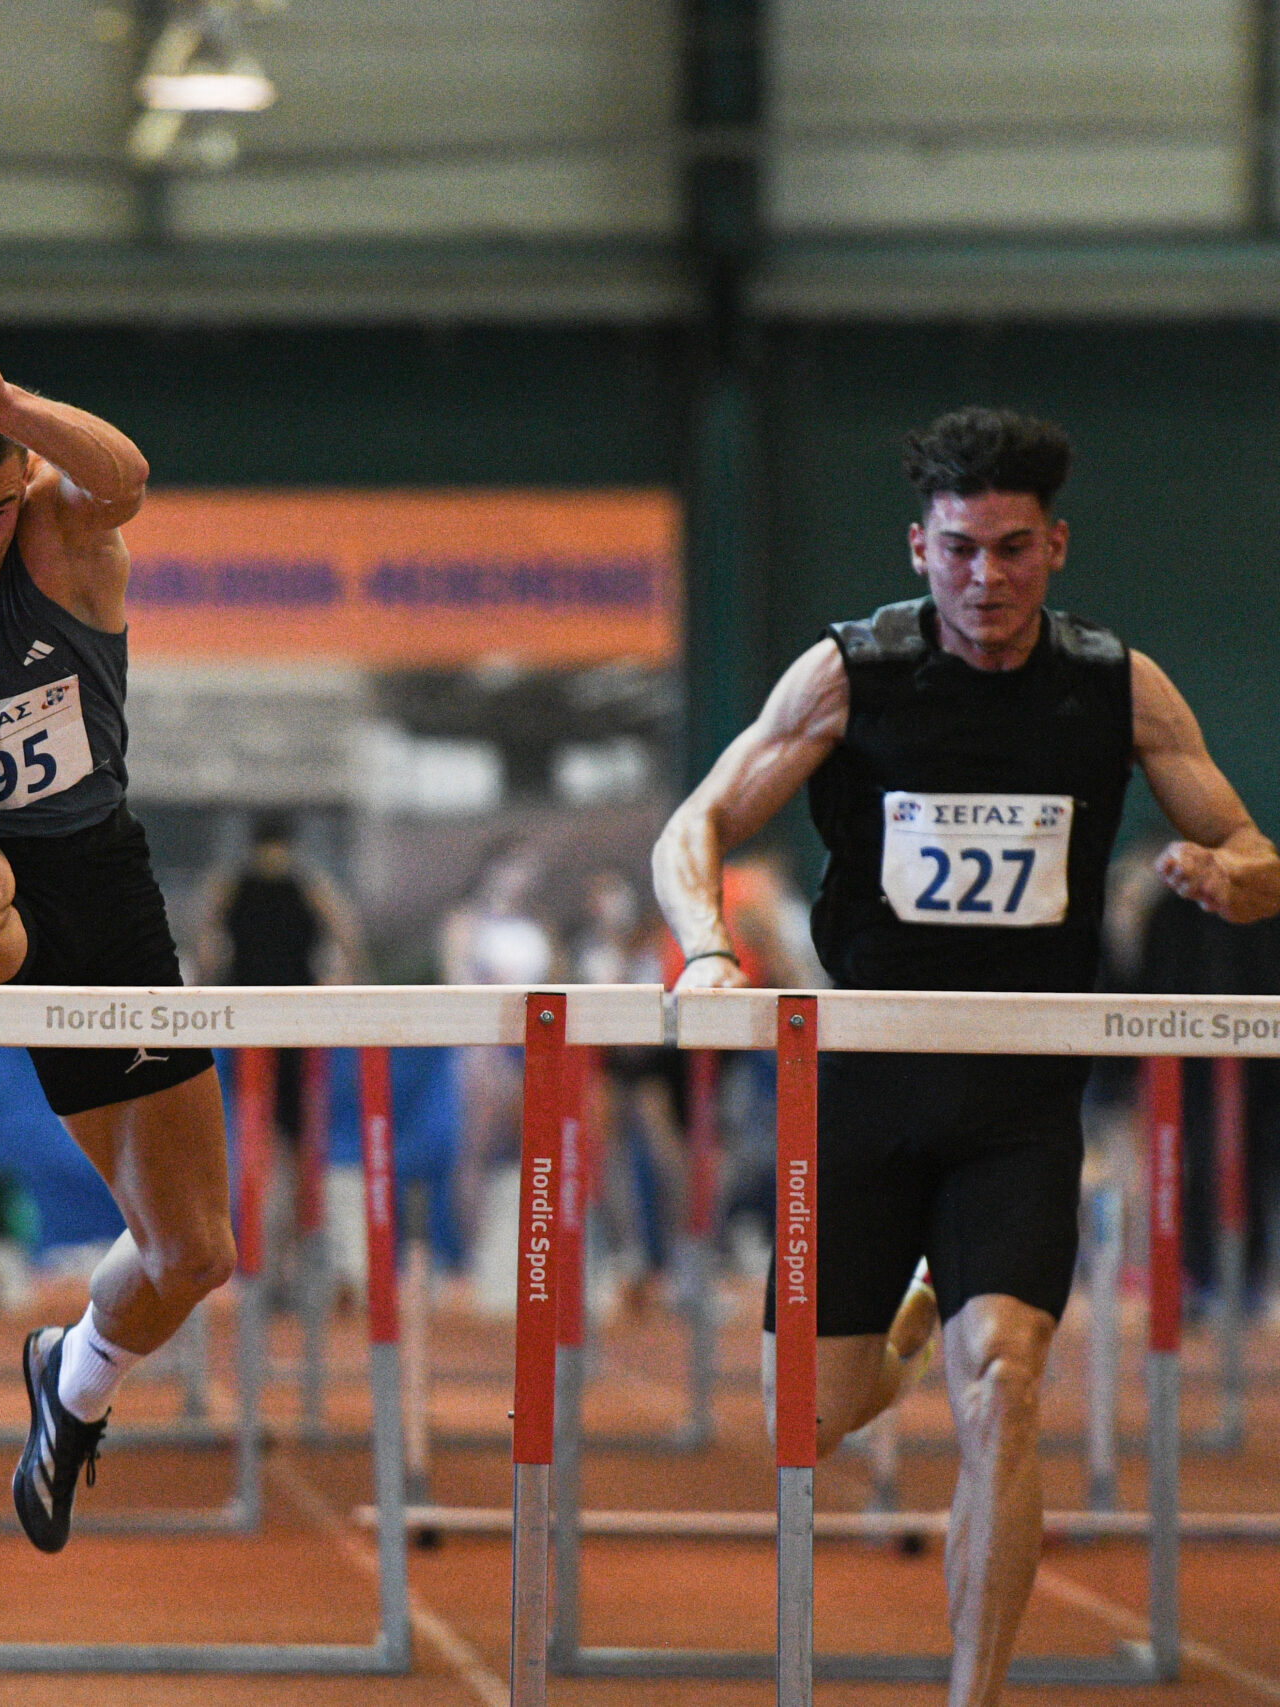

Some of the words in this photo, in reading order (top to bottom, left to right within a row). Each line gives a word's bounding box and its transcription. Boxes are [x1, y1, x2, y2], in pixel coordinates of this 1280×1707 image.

[934, 803, 1025, 829] ΣΕΓΑΣ
[915, 845, 1036, 913] 227
[150, 1005, 235, 1037] Sport
[525, 1237, 550, 1303] Sport
[783, 1239, 809, 1305] Sport
